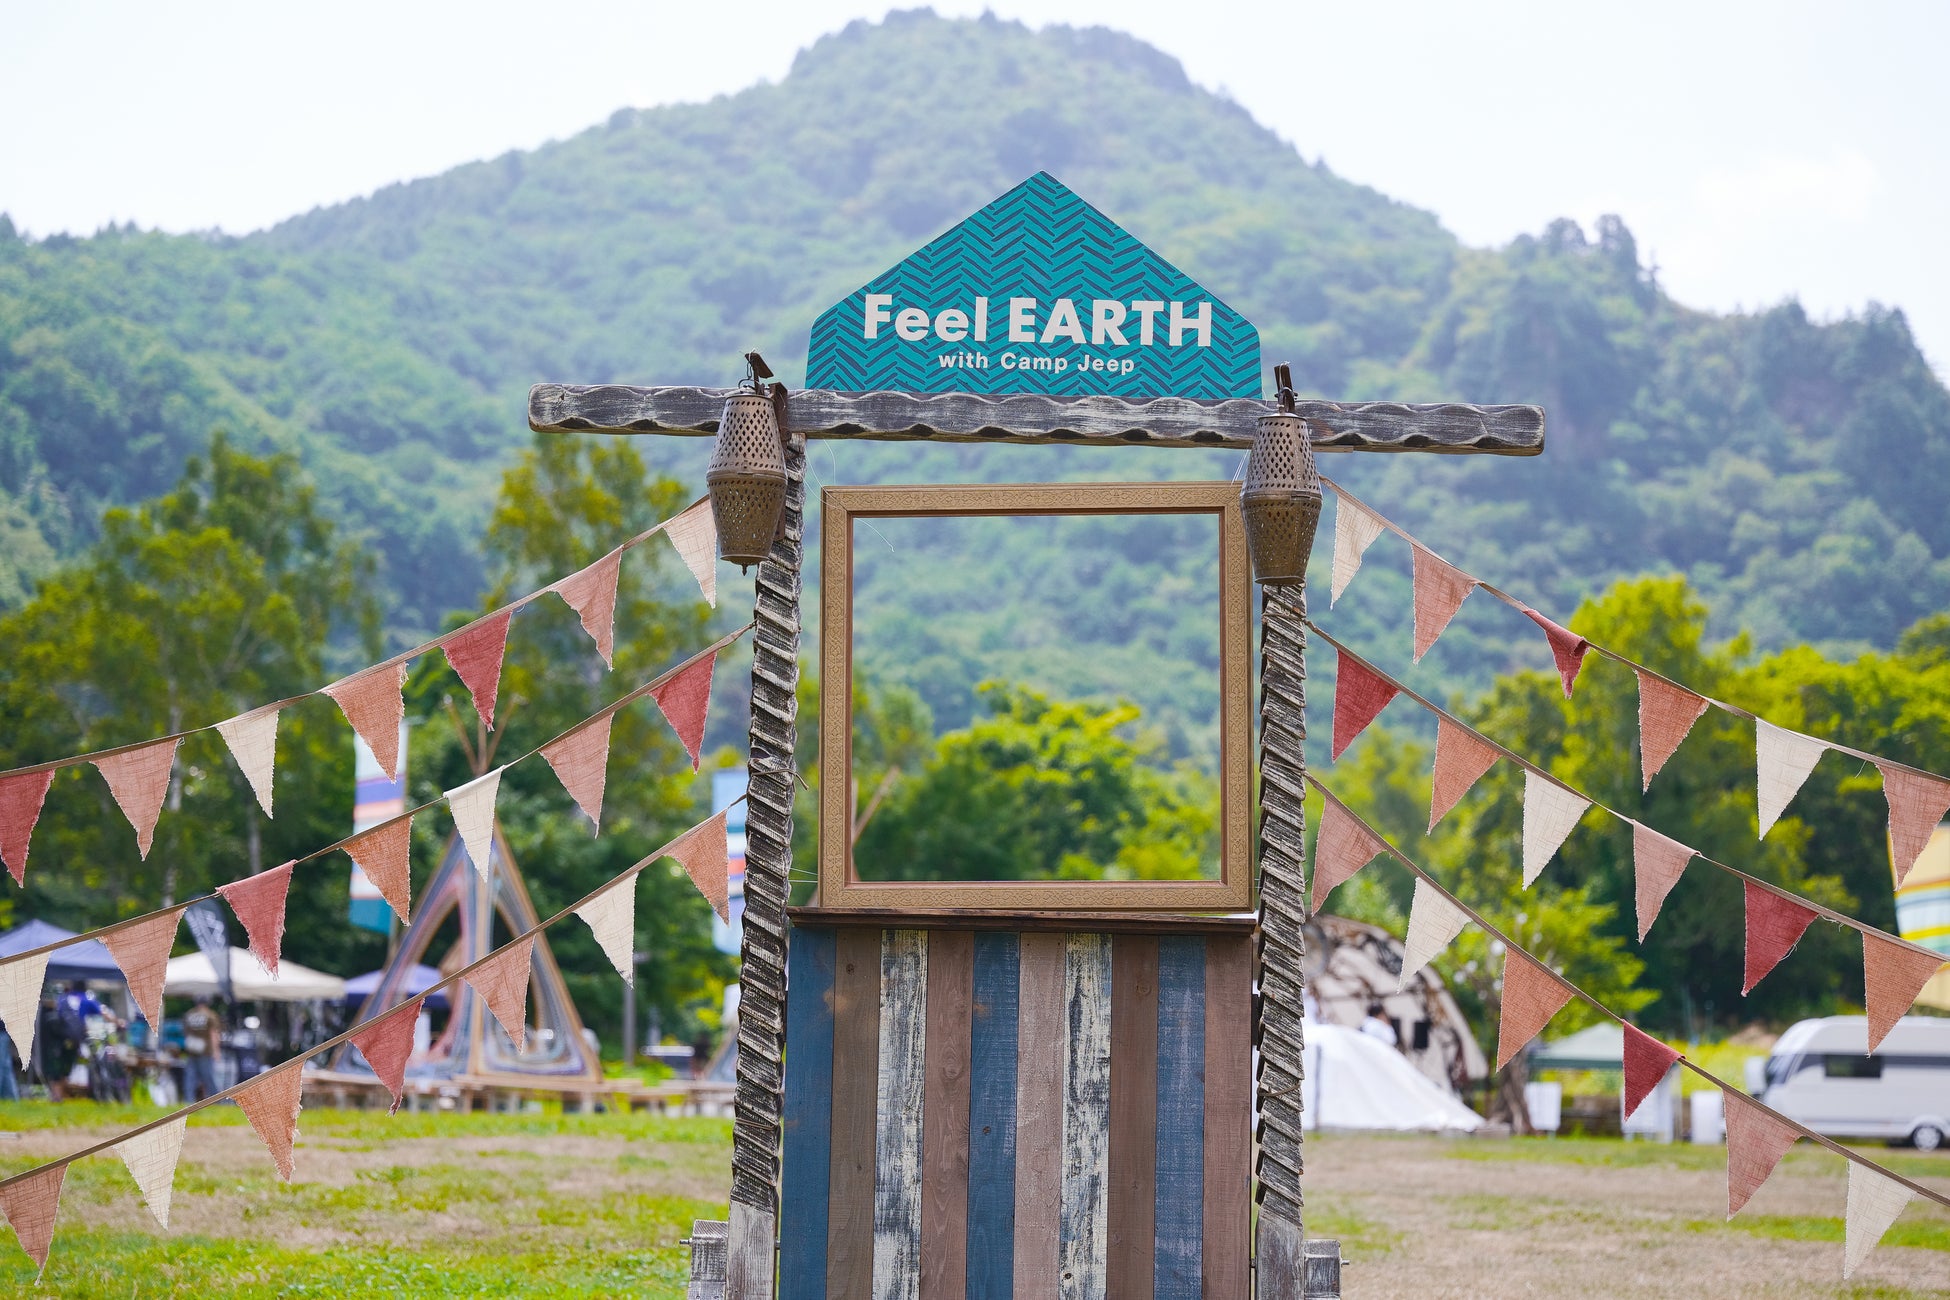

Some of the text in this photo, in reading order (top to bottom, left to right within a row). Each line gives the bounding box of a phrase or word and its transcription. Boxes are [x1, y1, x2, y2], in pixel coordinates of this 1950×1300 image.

[864, 294, 1212, 347] Feel EARTH
[938, 352, 1135, 376] with Camp Jeep
